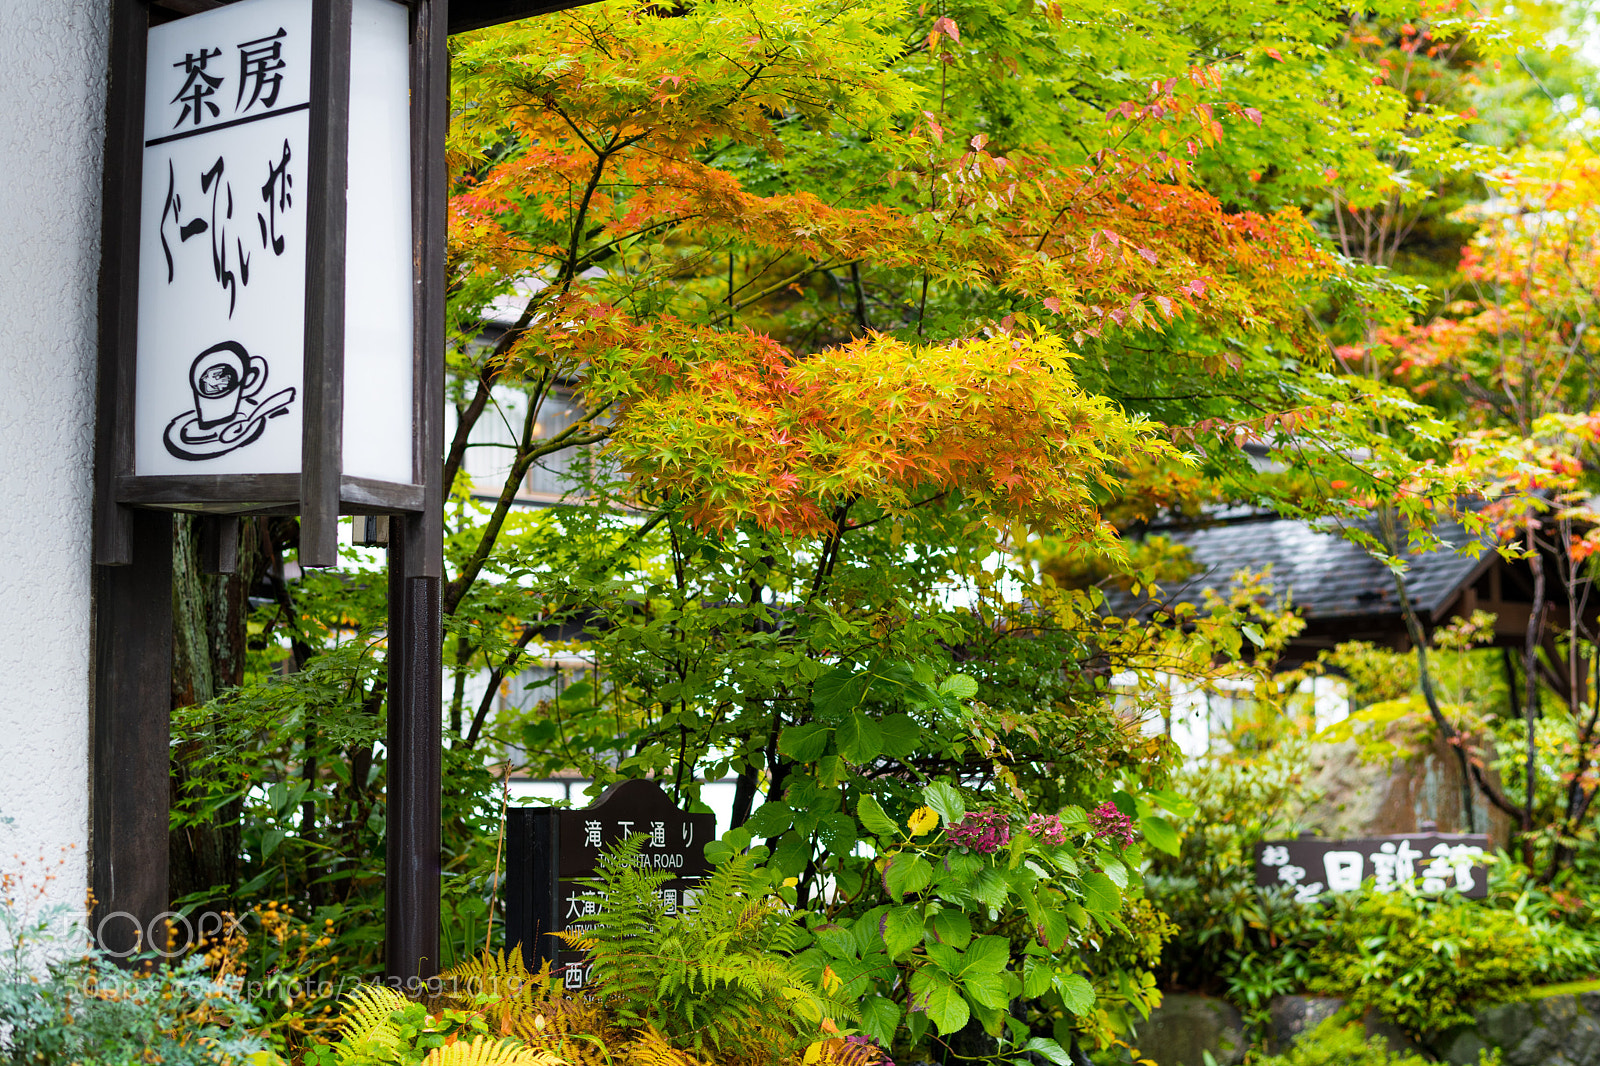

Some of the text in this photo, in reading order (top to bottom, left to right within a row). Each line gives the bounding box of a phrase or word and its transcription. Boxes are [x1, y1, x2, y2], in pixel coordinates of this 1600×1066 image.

[170, 27, 287, 130] 茶房
[584, 819, 694, 848] 滝下通り
[653, 853, 684, 868] ROAD
